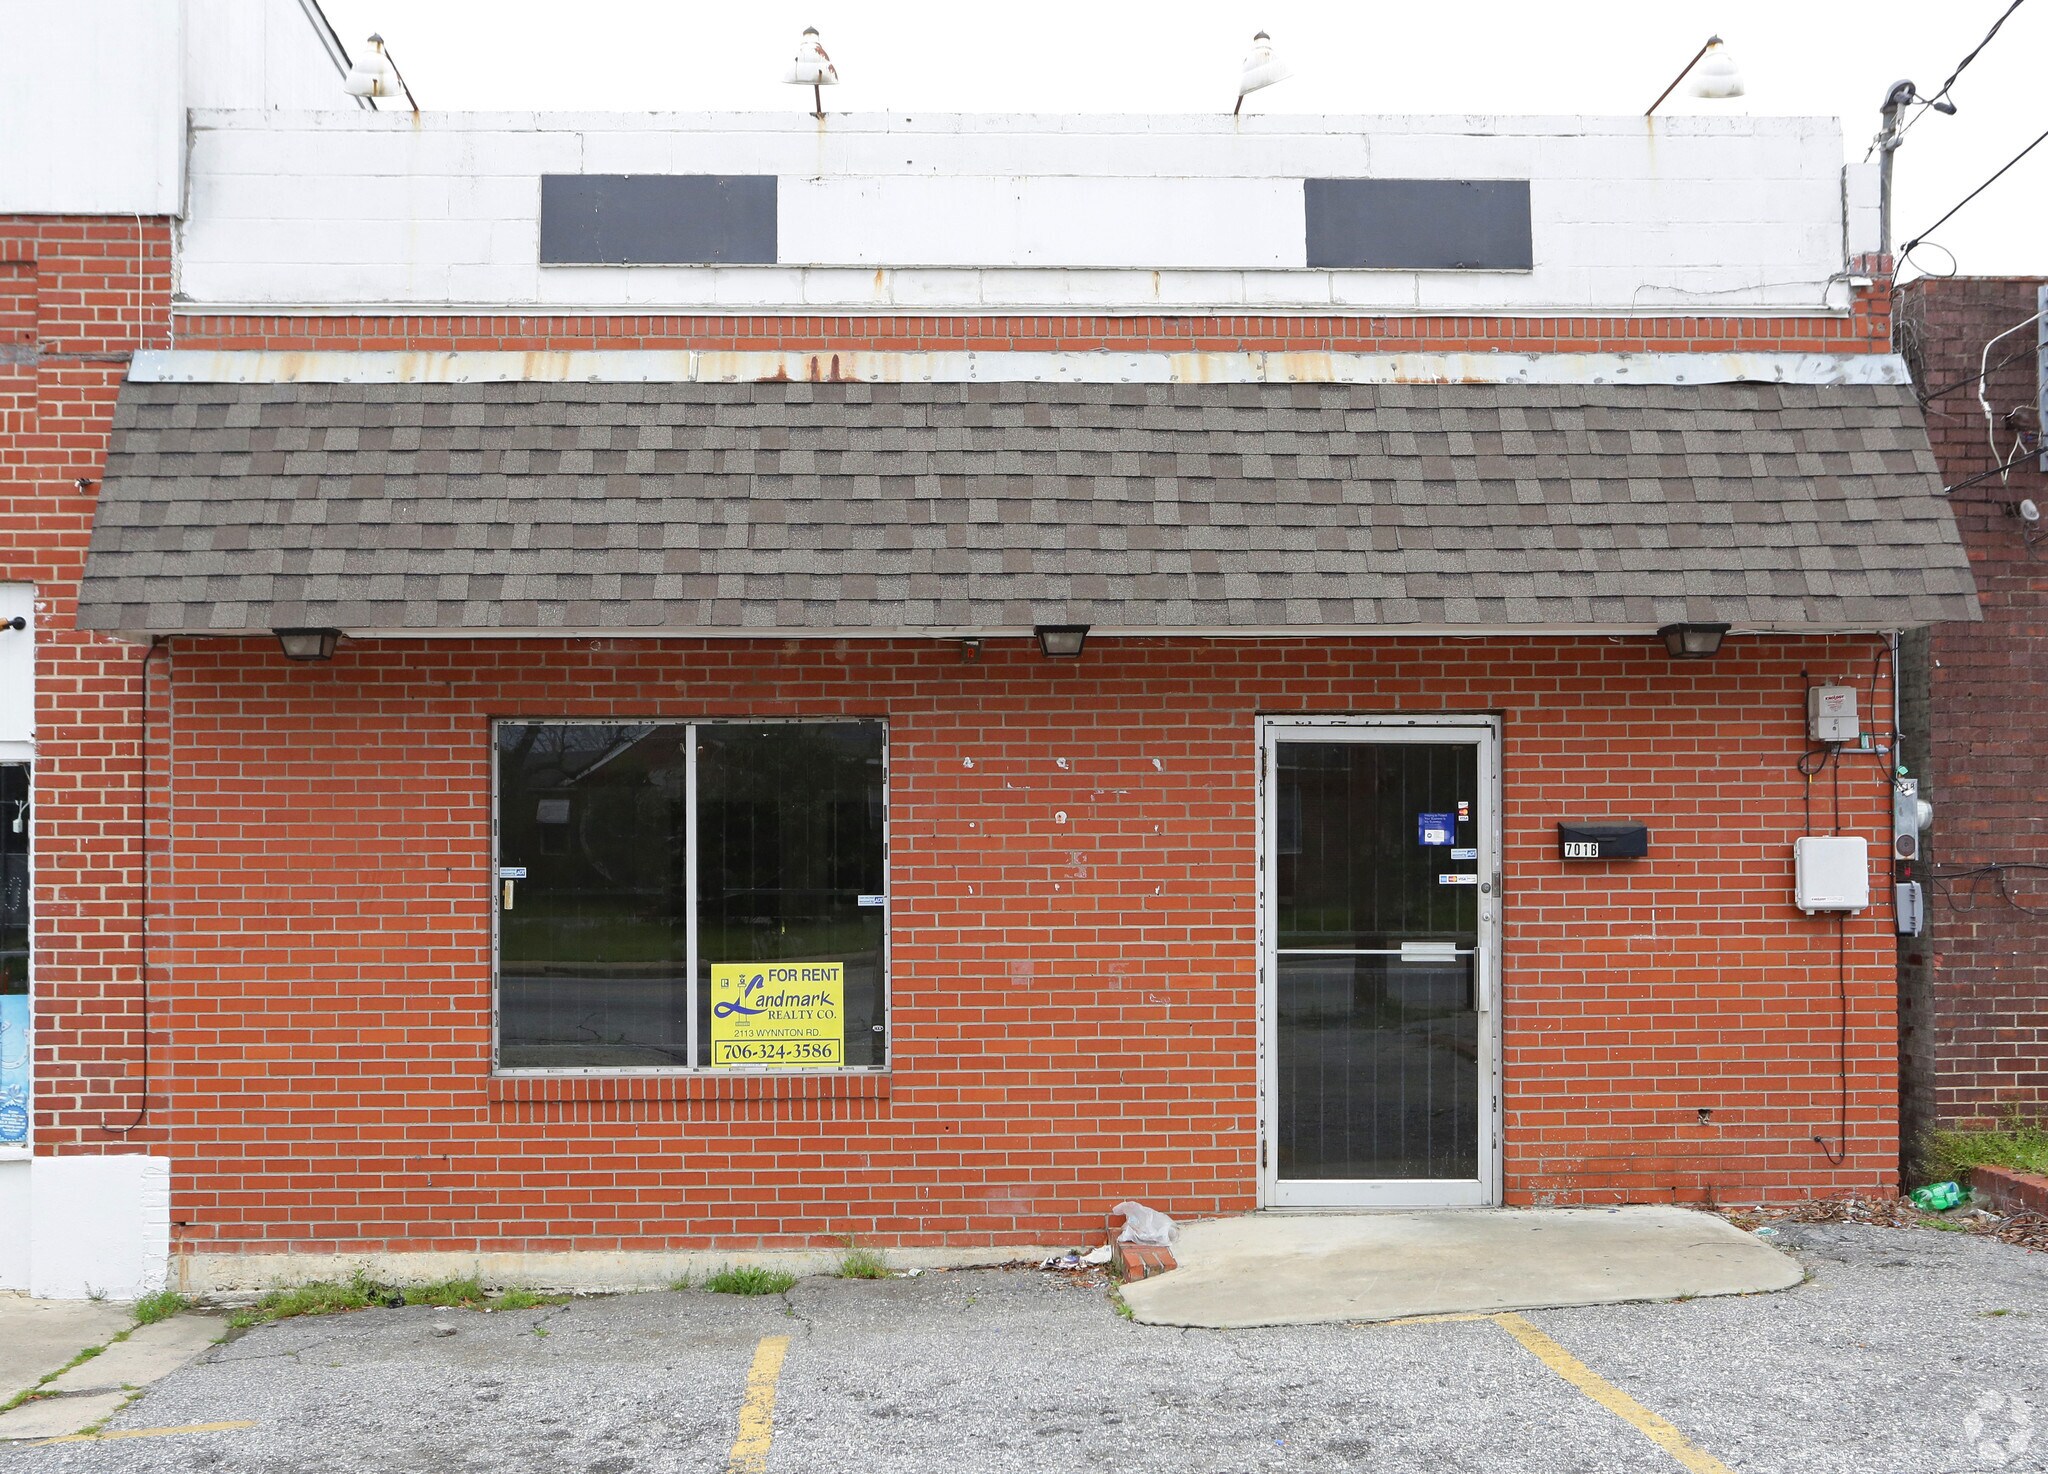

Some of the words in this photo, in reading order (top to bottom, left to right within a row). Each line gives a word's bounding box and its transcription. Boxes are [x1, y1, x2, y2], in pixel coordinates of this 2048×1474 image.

[1566, 843, 1597, 856] 701B
[768, 968, 798, 982] FOR
[801, 968, 839, 982] RENT
[714, 974, 834, 1018] Landmark
[768, 1010, 814, 1020] REALTY
[816, 1009, 837, 1020] CO.
[734, 1029, 754, 1038] 2113
[756, 1029, 803, 1038] WYNNTON
[805, 1028, 821, 1037] RD.
[723, 1043, 832, 1060] 706-324-3586
